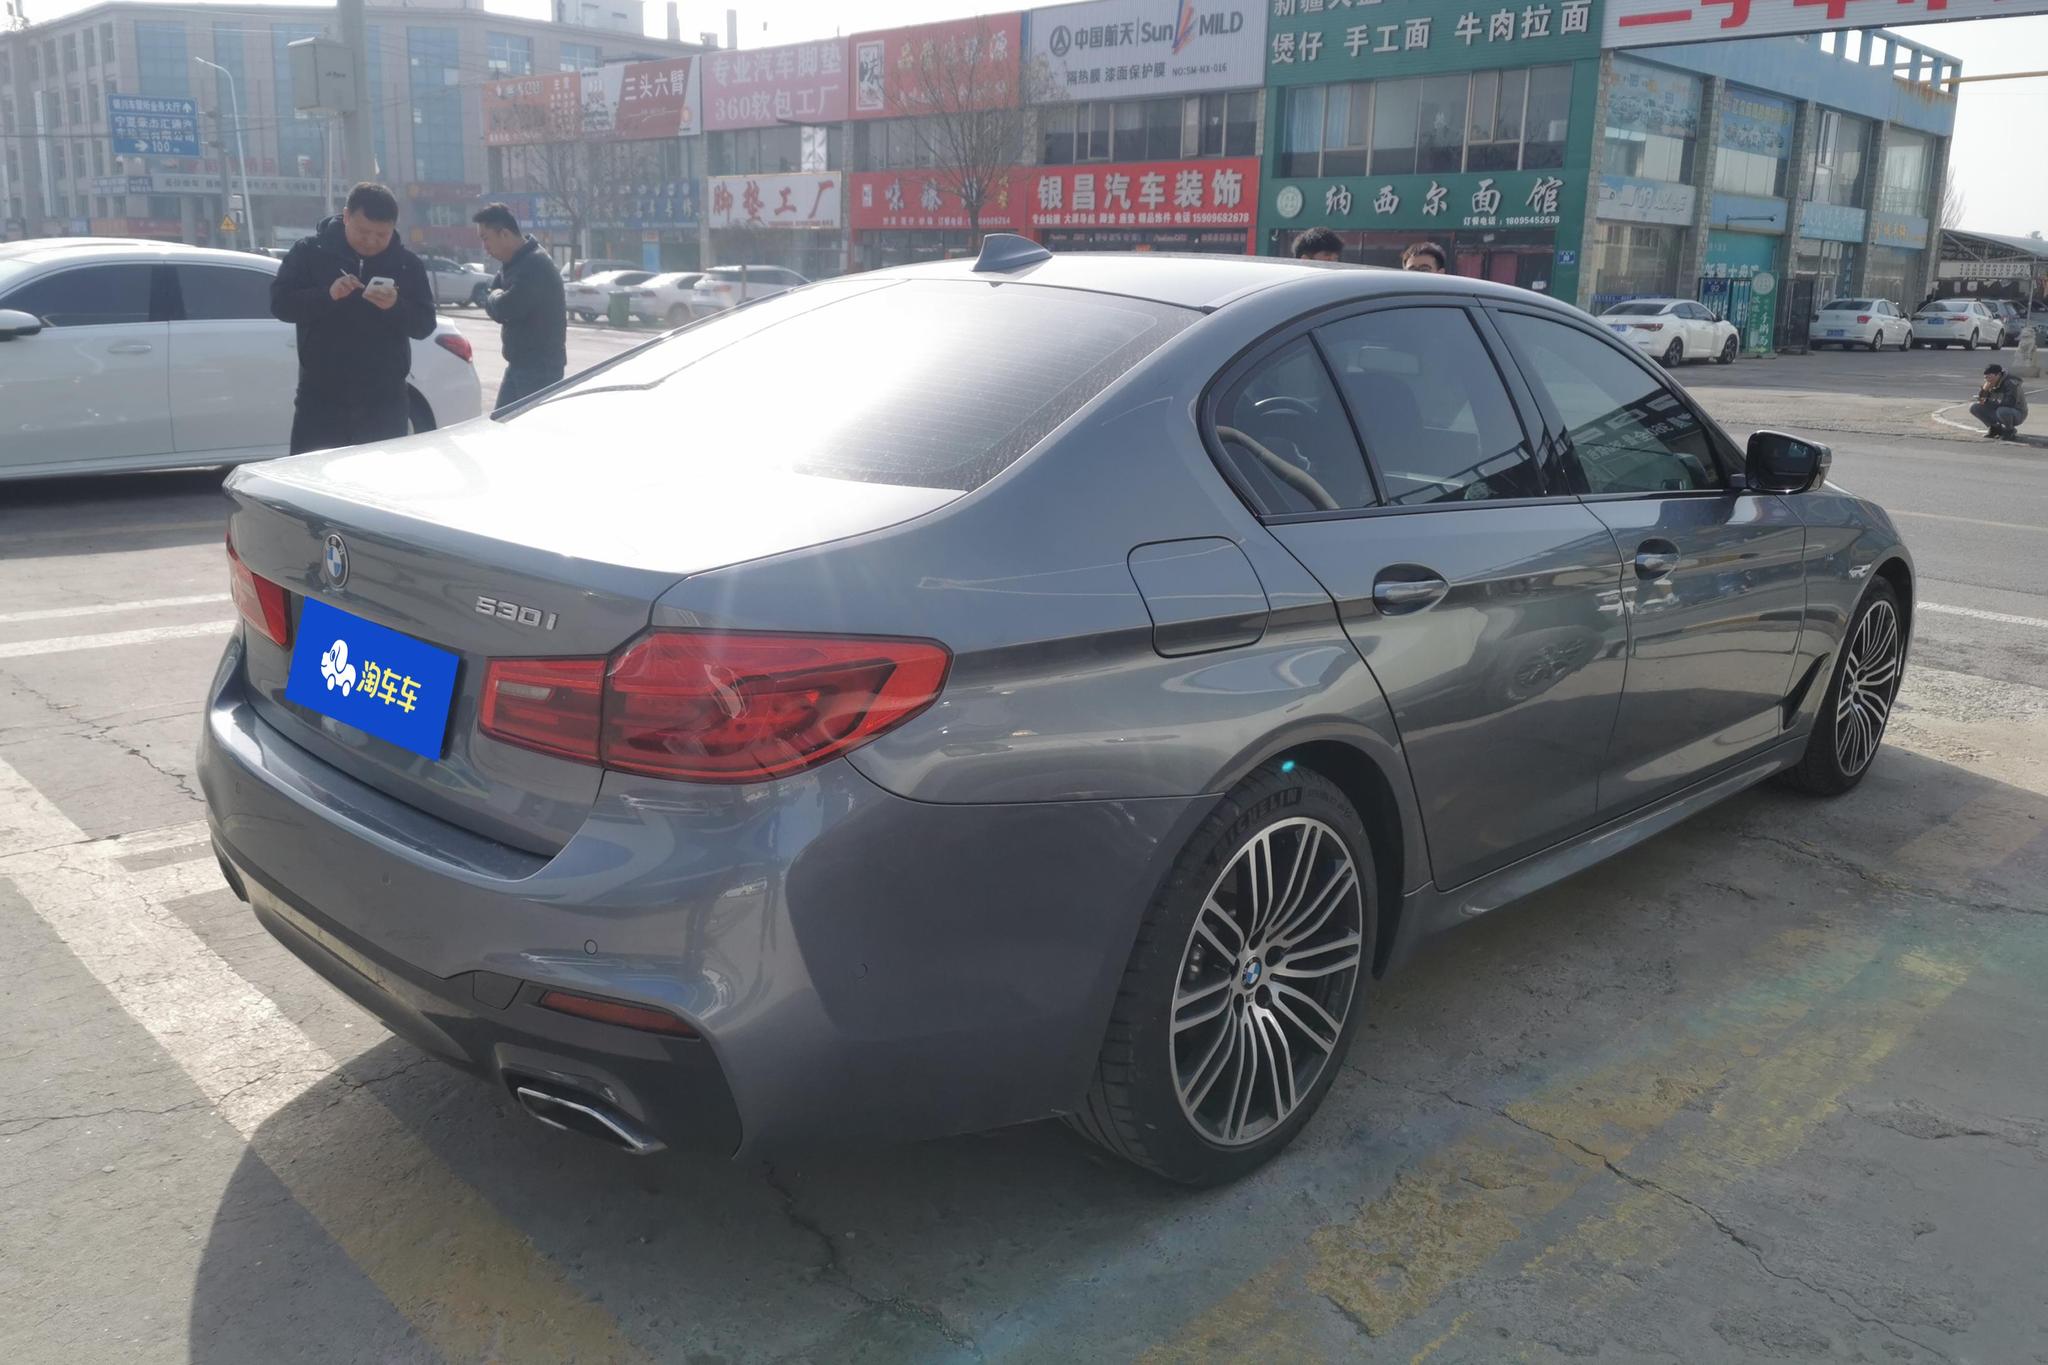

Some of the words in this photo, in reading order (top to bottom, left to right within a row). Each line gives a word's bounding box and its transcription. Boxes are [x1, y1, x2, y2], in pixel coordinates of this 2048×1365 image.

[1074, 22, 1134, 50] 中国航天
[1141, 22, 1174, 43] Sun
[1199, 11, 1244, 36] MILD
[1272, 31, 1323, 64] 煲仔
[1343, 17, 1433, 57] 手工面
[1454, 0, 1592, 47] 牛肉拉面
[713, 42, 842, 88] 专业汽车脚垫
[1104, 62, 1166, 83] 漆面保护膜
[624, 69, 685, 101] 三头六臂
[714, 85, 839, 120] 360软包工厂
[713, 180, 835, 224] 脚垫工厂
[1037, 168, 1244, 211] 银昌汽车装饰
[1325, 177, 1564, 217] 纳西尔面馆
